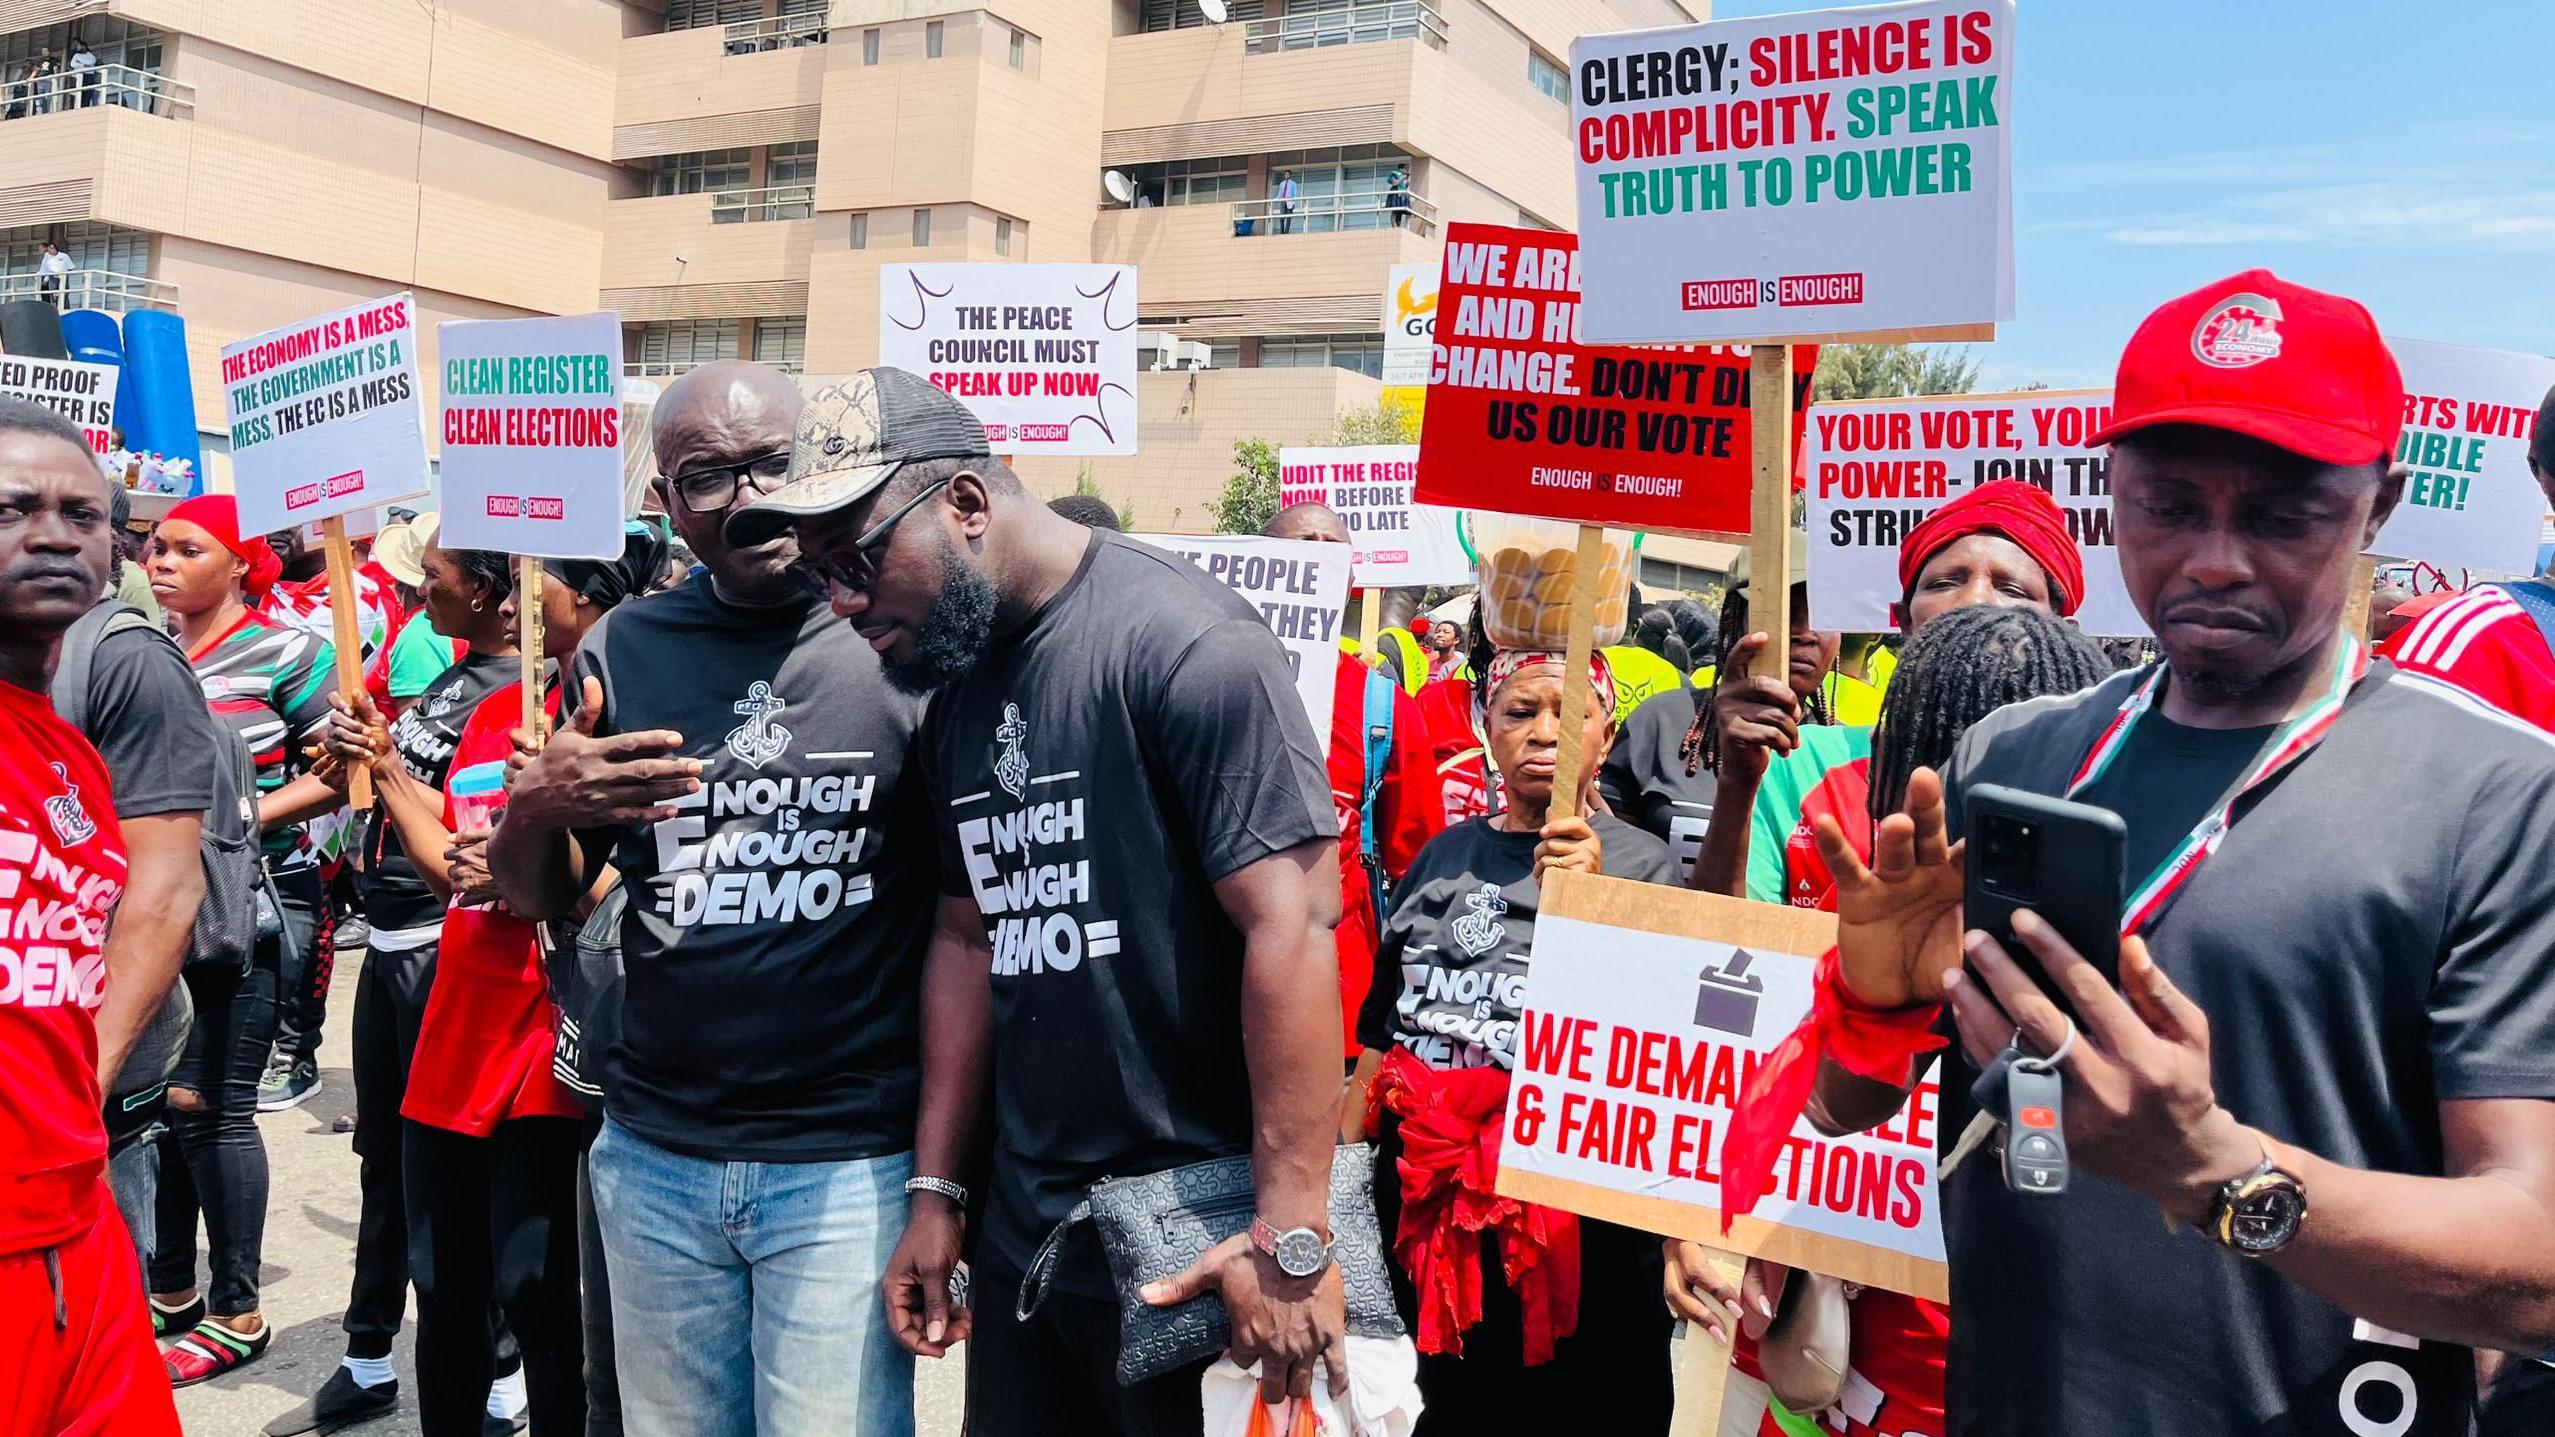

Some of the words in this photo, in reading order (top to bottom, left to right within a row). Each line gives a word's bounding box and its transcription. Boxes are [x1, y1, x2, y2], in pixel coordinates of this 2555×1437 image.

[1580, 43, 1739, 107] CLERGY;
[1749, 18, 1931, 88] SILENCE
[1943, 11, 1992, 66] IS
[1579, 91, 1836, 164] COMPLICITY.
[1846, 74, 2000, 140] SPEAK
[1599, 162, 1728, 218] TRUTH
[1737, 156, 1793, 208] TO
[1805, 142, 1972, 203] POWER
[1448, 242, 1508, 287] WE
[1686, 282, 1754, 308] ENOUGH
[1760, 281, 1776, 303] IS
[1781, 275, 1860, 304] ENOUGH!
[955, 306, 997, 330] THE
[1003, 306, 1073, 331] PEACE
[1454, 295, 1534, 340] AND
[2215, 318, 2254, 341] 24
[222, 353, 246, 384] THE
[249, 327, 320, 375] ECONOMY
[324, 321, 341, 350] IS
[344, 316, 356, 344] A
[358, 301, 410, 340] MESS,
[929, 339, 1029, 364] COUNCIL
[1034, 340, 1100, 364] MUST
[0, 361, 26, 387] ED
[31, 364, 101, 395] PROOF
[232, 382, 259, 415] THE
[260, 349, 365, 406] GOVERNMENT
[368, 343, 386, 372] IS
[390, 339, 402, 366] A
[447, 357, 503, 395] CLEAN
[509, 354, 614, 398] REGISTER,
[929, 372, 1002, 396] SPEAK
[1007, 373, 1038, 396] UP
[1043, 373, 1100, 396] NOW
[1427, 343, 1581, 396] CHANGE.
[1590, 357, 1705, 404] DON'T
[1712, 366, 1813, 412] DY
[89, 400, 110, 426] IS
[231, 414, 275, 451] MESS,
[275, 404, 304, 436] THE
[307, 396, 325, 426] EC
[329, 390, 345, 420] IS
[349, 387, 360, 414] A
[361, 372, 411, 409] MESS
[445, 408, 500, 445] CLEAN
[506, 407, 618, 448] ELECTIONS
[1487, 401, 1537, 443] US
[1547, 405, 1626, 450] OUR
[1637, 412, 1733, 458] VOTE
[1817, 411, 1911, 452] YOUR
[1920, 408, 2023, 451] VOTE,
[2466, 402, 2539, 440] WIT
[984, 426, 1005, 439] UGH
[1008, 426, 1018, 439] IS
[1021, 426, 1067, 440] ENOUGH!
[287, 484, 318, 509] ENOUGH
[320, 482, 327, 498] IS
[327, 472, 363, 497] ENOUGH!
[1330, 464, 1365, 482] THE
[1371, 462, 1418, 482] REGI
[1531, 467, 1592, 490] ENOUGH
[1596, 473, 1611, 491] IS
[1614, 474, 1683, 498] ENOUGH!
[2064, 458, 2111, 496] TH
[488, 496, 519, 516] ENOUGH
[520, 499, 527, 515] IS
[529, 498, 562, 518] ENOUGH!
[1335, 487, 1405, 507] BEFORE
[1367, 511, 1409, 530] LATE
[1208, 554, 1319, 595] PEOPLE
[778, 809, 800, 831] IS
[1473, 1000, 1492, 1020] IS
[1524, 1010, 1597, 1083] WE
[1513, 1084, 1546, 1147] &
[1556, 1093, 1657, 1173] FAIR
[1668, 1115, 1925, 1228] ELTIONS
